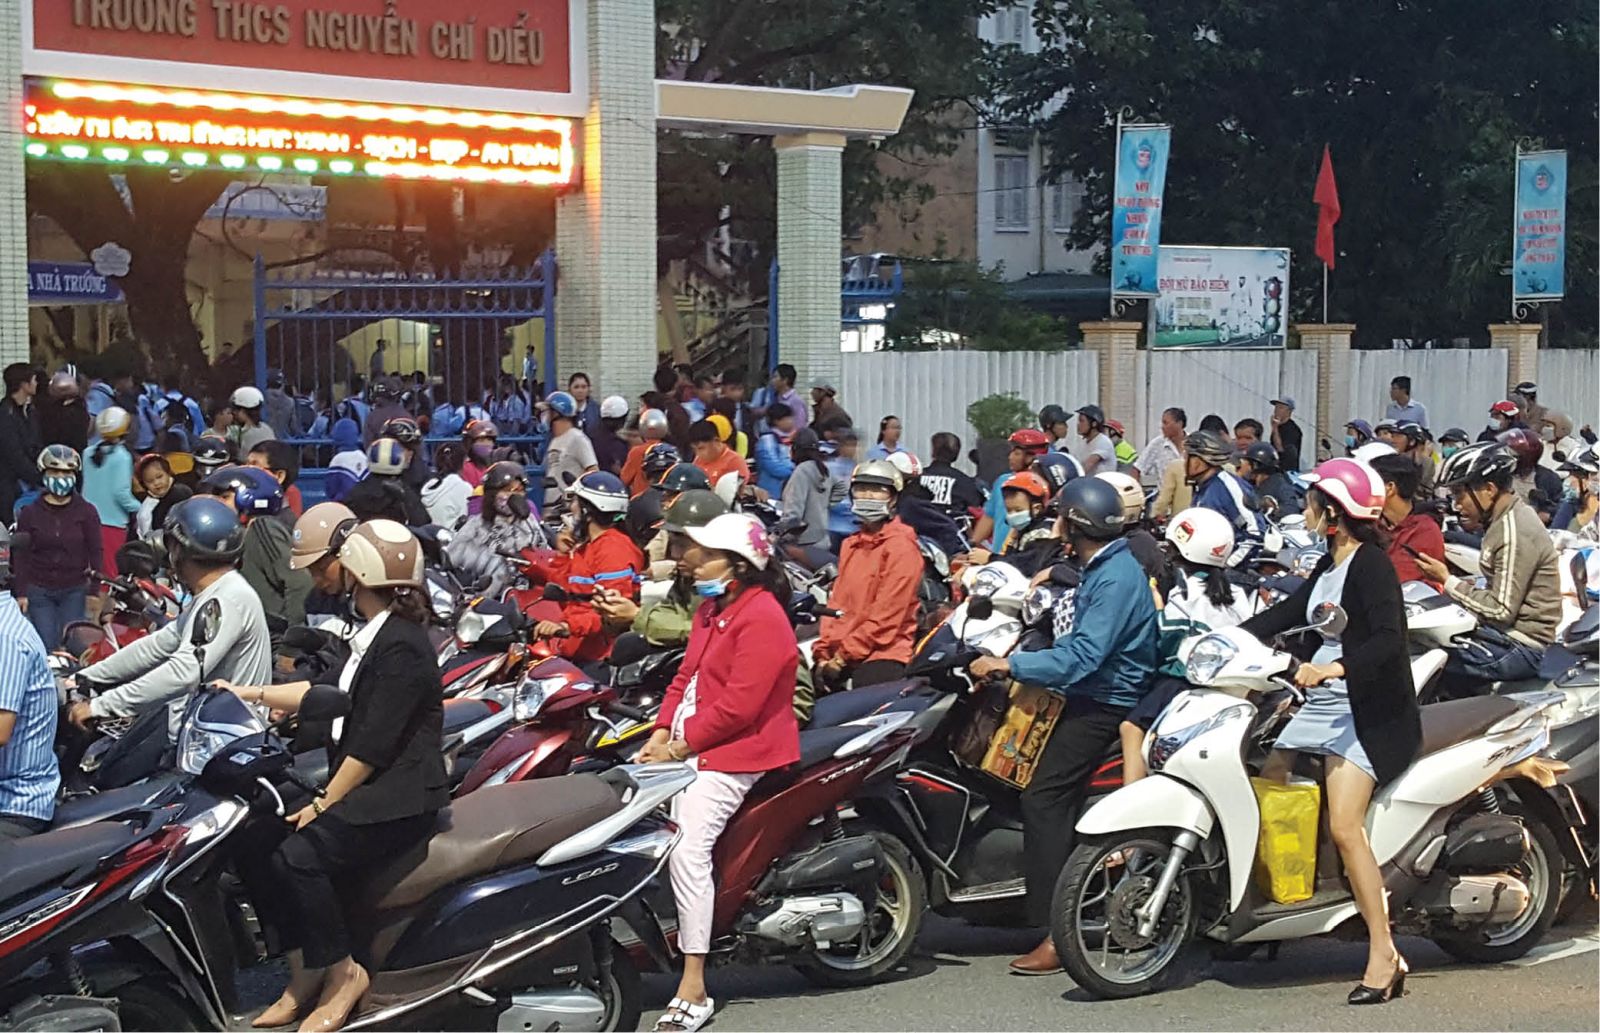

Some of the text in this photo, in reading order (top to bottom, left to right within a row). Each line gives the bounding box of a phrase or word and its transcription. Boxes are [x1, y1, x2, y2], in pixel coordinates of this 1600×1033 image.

[212, 1, 292, 44] THCS
[430, 16, 476, 61] CHÍ
[561, 862, 620, 886] LEAD
